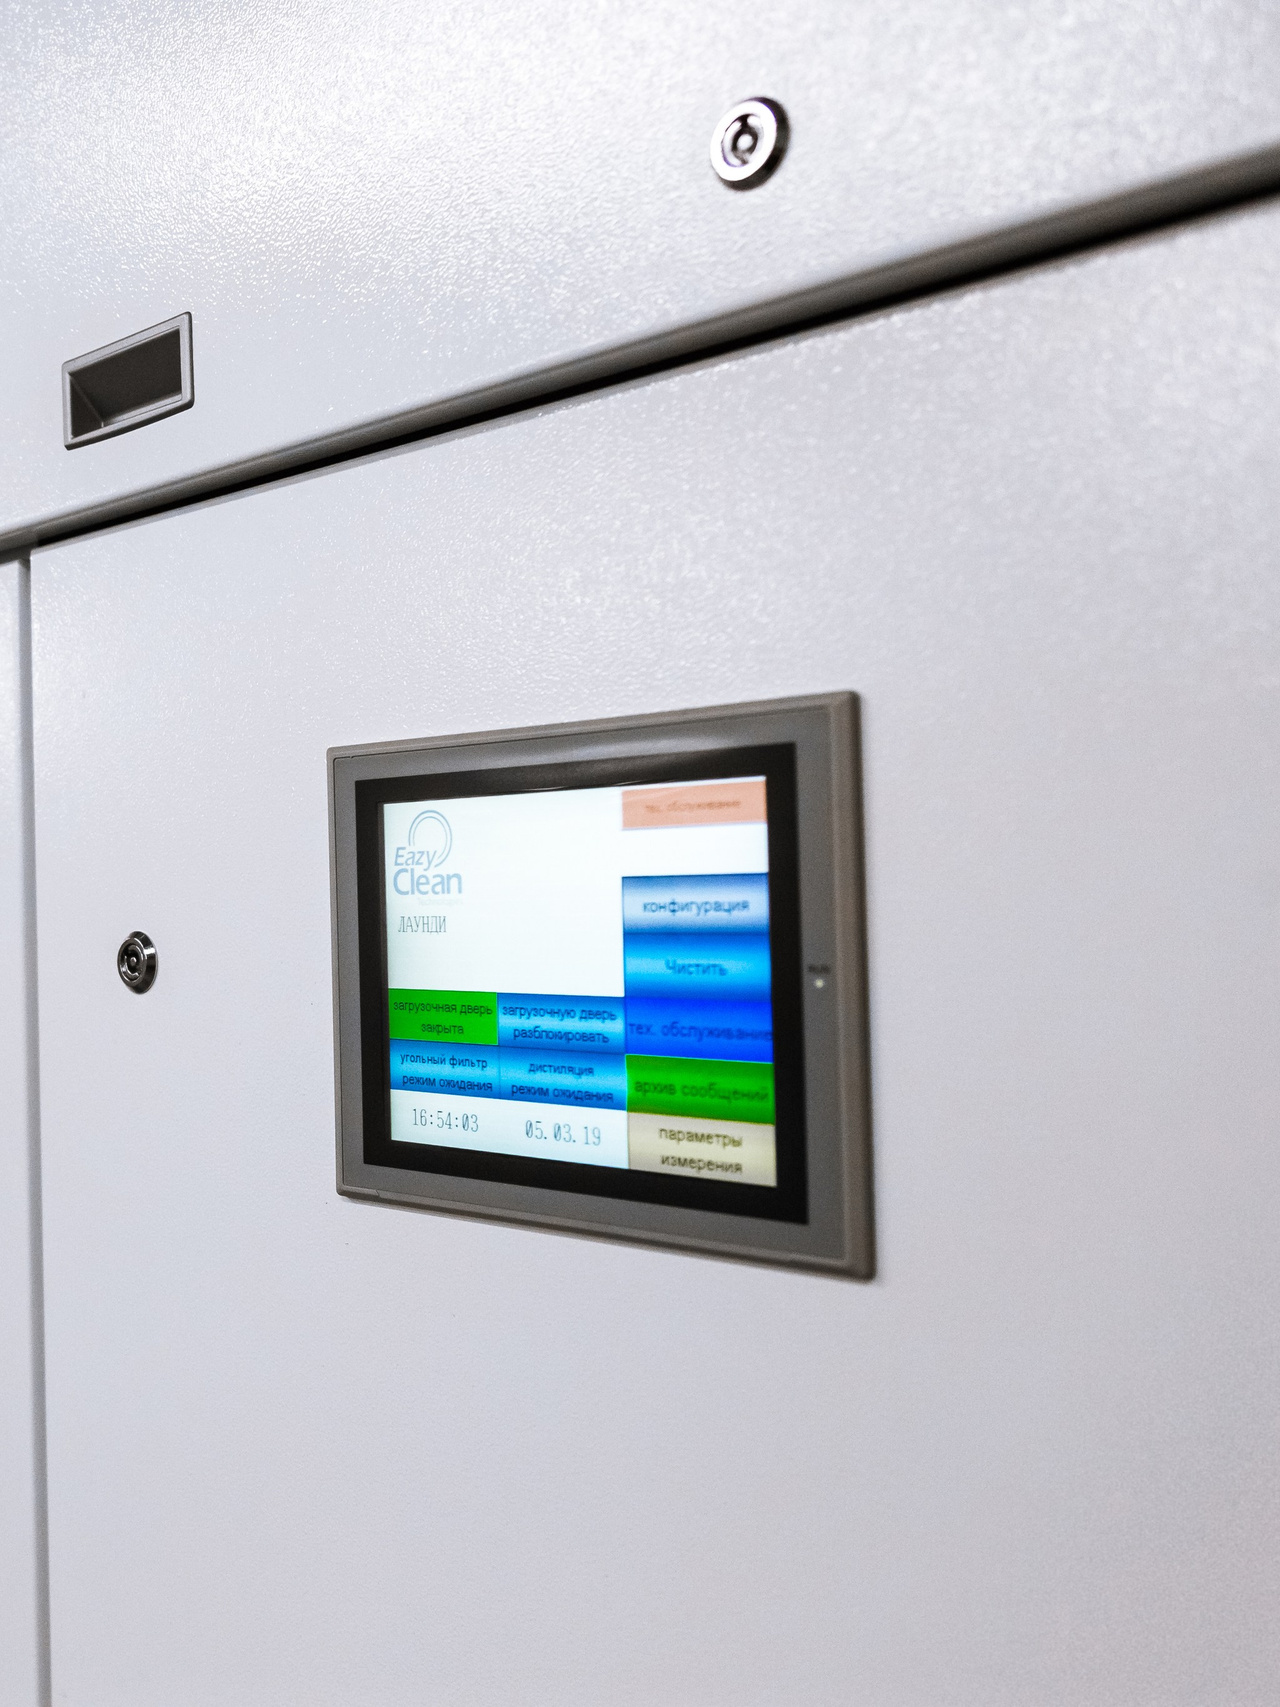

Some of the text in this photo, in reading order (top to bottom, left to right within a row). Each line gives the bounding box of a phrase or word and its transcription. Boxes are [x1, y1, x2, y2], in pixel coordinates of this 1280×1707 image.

[394, 846, 438, 872] Eazy
[393, 868, 463, 896] Clean
[642, 898, 750, 917] конфигурация
[398, 915, 447, 934] ЛАУНДИ
[664, 959, 728, 977] Чистить
[393, 1001, 493, 1016] загрузочная дверь
[502, 1005, 618, 1024] загрузочную дверь
[421, 1022, 464, 1036] закрыта
[513, 1026, 610, 1044] разблокировать
[400, 1052, 488, 1071] угольный фильтр
[528, 1062, 595, 1078] дистиляция
[402, 1074, 493, 1092] режим ожидания
[511, 1083, 615, 1102] режим ожидания
[634, 1080, 770, 1104] архив сообщений
[412, 1108, 479, 1133] 16:54:03
[658, 1127, 744, 1150] параметры
[660, 1154, 744, 1175] измерения
